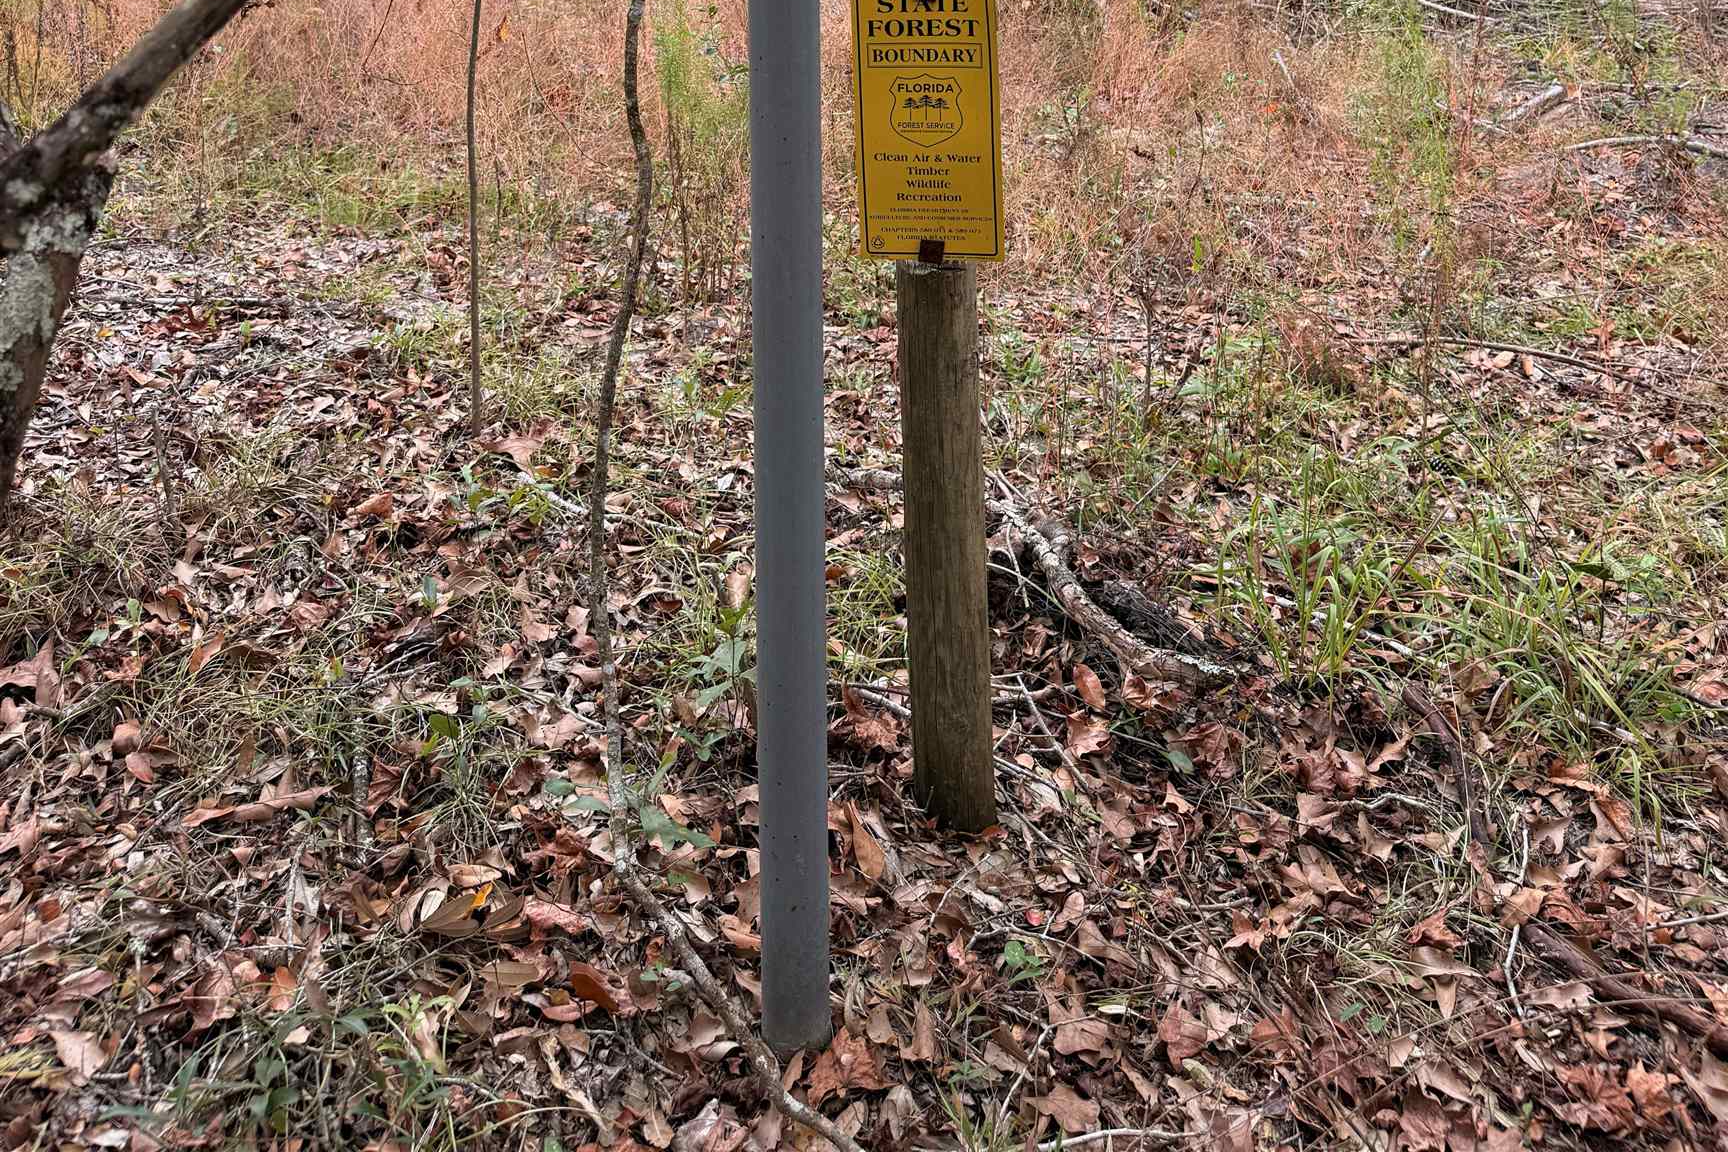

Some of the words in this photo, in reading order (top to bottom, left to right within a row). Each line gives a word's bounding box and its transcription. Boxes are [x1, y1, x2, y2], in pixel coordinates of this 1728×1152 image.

[867, 18, 980, 37] FOREST
[872, 48, 977, 63] BOUNDARY
[897, 83, 954, 93] FLORIDA
[897, 121, 924, 129] FOREST
[874, 152, 908, 162] Clean
[912, 153, 929, 162] Air
[934, 154, 943, 163] &
[947, 153, 982, 163] Water
[906, 166, 951, 176] Timber
[906, 179, 952, 189] Wildlife
[896, 192, 962, 202] Recreation
